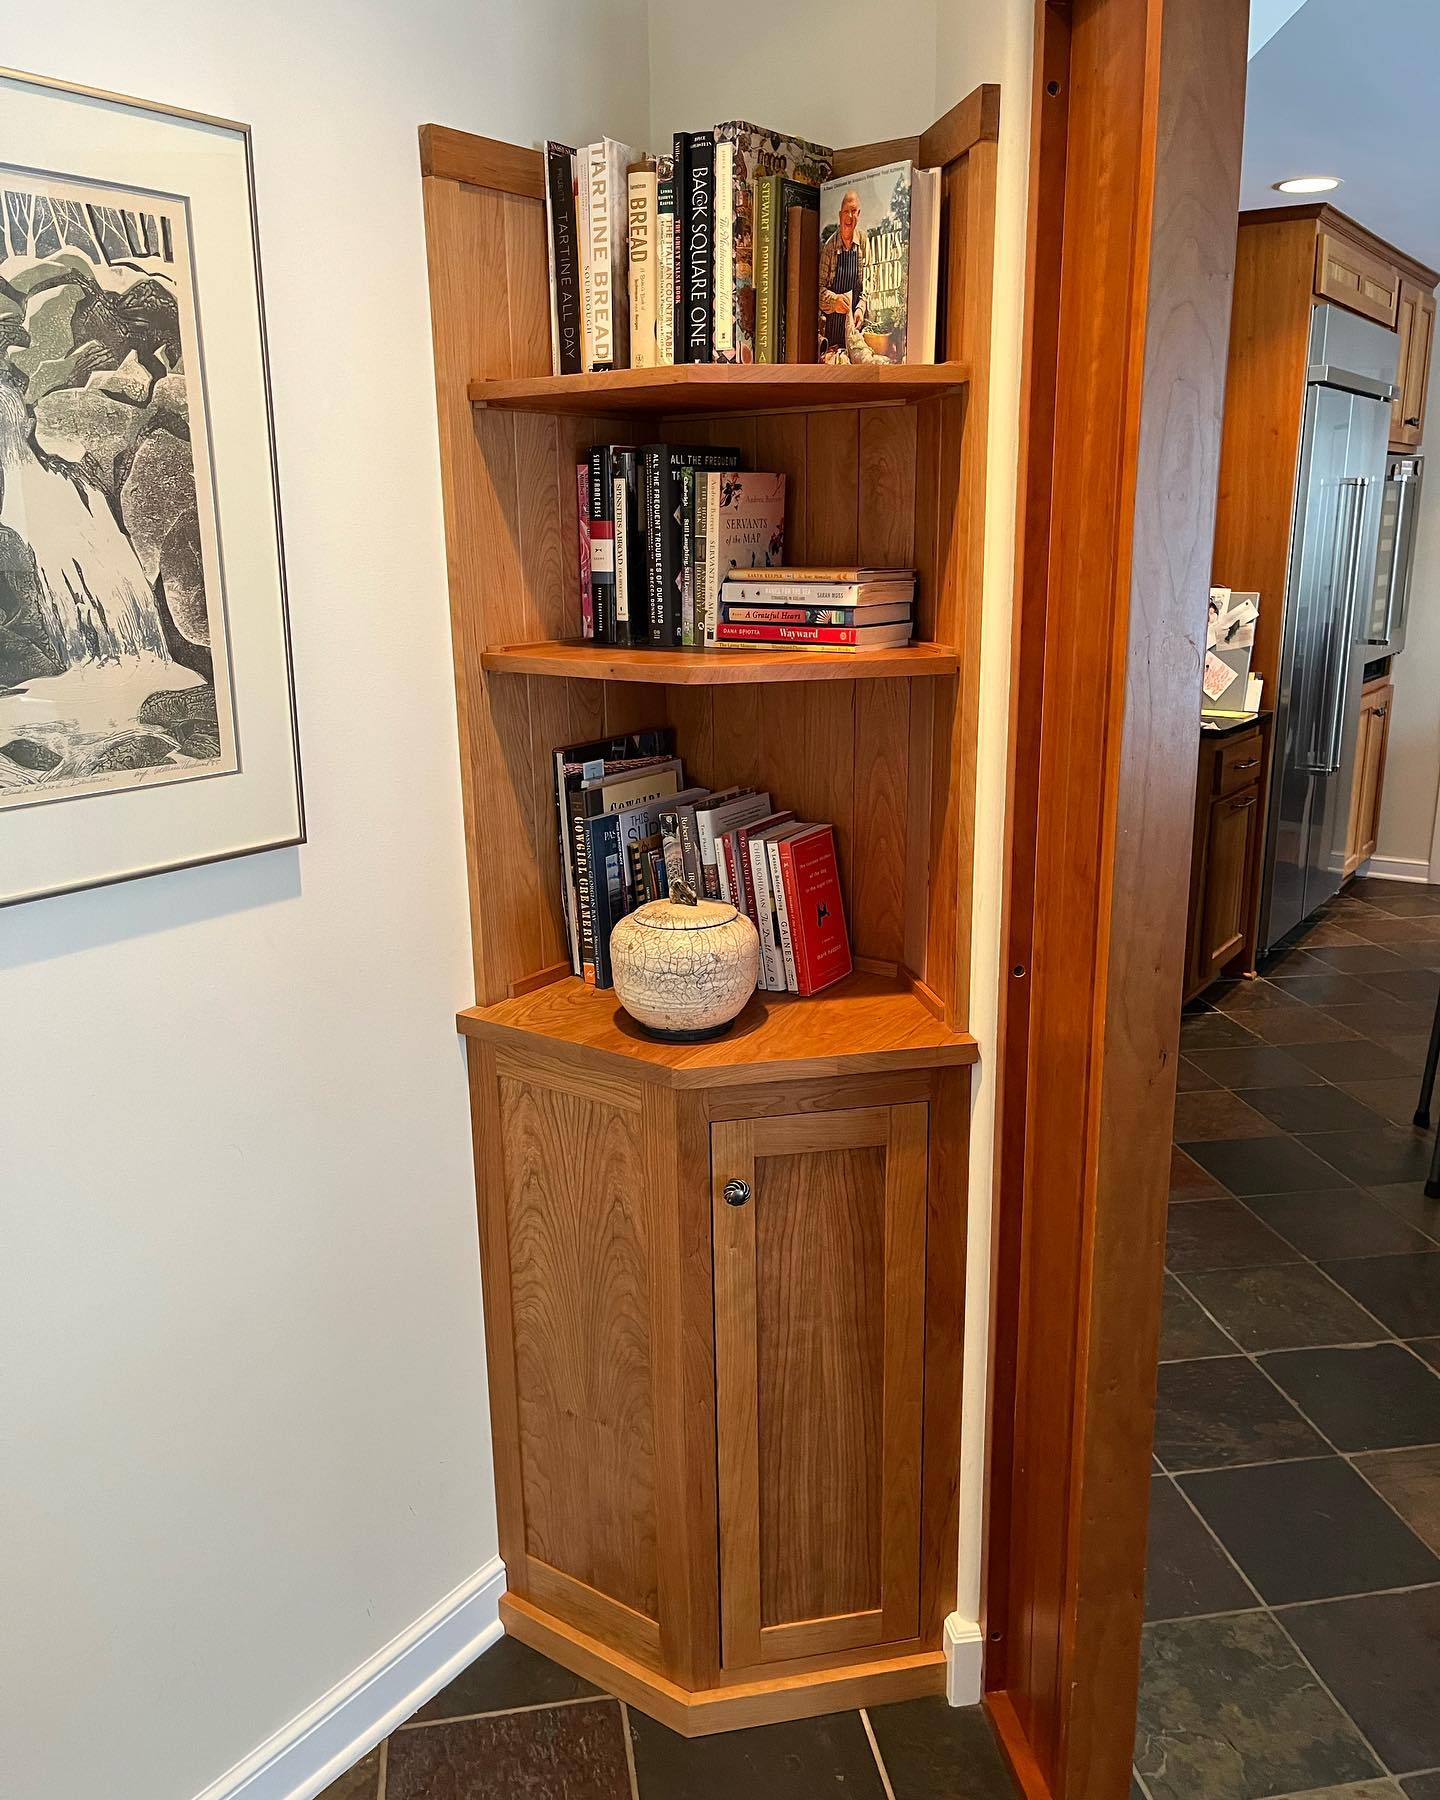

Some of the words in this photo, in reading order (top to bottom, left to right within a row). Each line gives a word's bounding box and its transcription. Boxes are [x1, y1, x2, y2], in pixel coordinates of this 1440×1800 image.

[591, 143, 609, 263] TARTINE
[692, 167, 708, 221] BACK
[761, 182, 770, 231] STEWART
[630, 197, 648, 262] BREAD
[665, 219, 673, 238] THE
[557, 212, 572, 286] TARTINE
[665, 240, 673, 280] ITALIAN
[689, 223, 708, 301] SQUARE
[863, 231, 902, 267] JAMES
[759, 245, 769, 294] DRUNKEN
[862, 261, 902, 294] BEARD
[562, 292, 575, 322] ALL
[585, 265, 593, 335] SOURDOUGH
[594, 271, 610, 360] BREAD
[719, 290, 730, 321] Kitchen
[690, 307, 707, 348] ONE
[758, 298, 768, 348] BOTANIST
[564, 327, 576, 360] DAY
[593, 454, 601, 476] SUITE
[670, 454, 685, 465] ALL
[688, 455, 702, 465] THE
[705, 456, 737, 467] FREQUENT
[616, 483, 624, 528] SPINSTERS
[653, 489, 661, 530] FREQUENT
[725, 537, 731, 547] of
[732, 536, 742, 546] the
[743, 533, 761, 545] MAP
[726, 518, 768, 530] SERVANTS
[616, 529, 625, 565] ABROAD
[654, 532, 662, 573] TROUBLES
[656, 575, 663, 586] OF
[738, 628, 761, 636] SPIOTTA
[752, 611, 779, 621] Grateful
[781, 612, 801, 620] Heart
[779, 628, 819, 640] Wayward
[629, 811, 649, 826] THIS
[680, 816, 690, 841] Robert
[573, 816, 588, 874] COWGIRL
[683, 842, 692, 854] Bly
[740, 836, 747, 848] 90
[752, 842, 763, 866] CHRIS
[688, 871, 697, 890] IRO
[742, 851, 753, 891] MINUTES
[771, 854, 779, 874] Lesson
[588, 871, 596, 908] GEORGIAN
[747, 895, 754, 905] IN
[756, 868, 768, 908] BOHJALIAN
[773, 875, 782, 893] Before
[578, 878, 593, 944] CREAMERY
[775, 894, 785, 911] Dying
[759, 912, 770, 927] The
[761, 928, 772, 953] Double
[780, 921, 792, 963] GAINES
[764, 955, 776, 973] Bind
